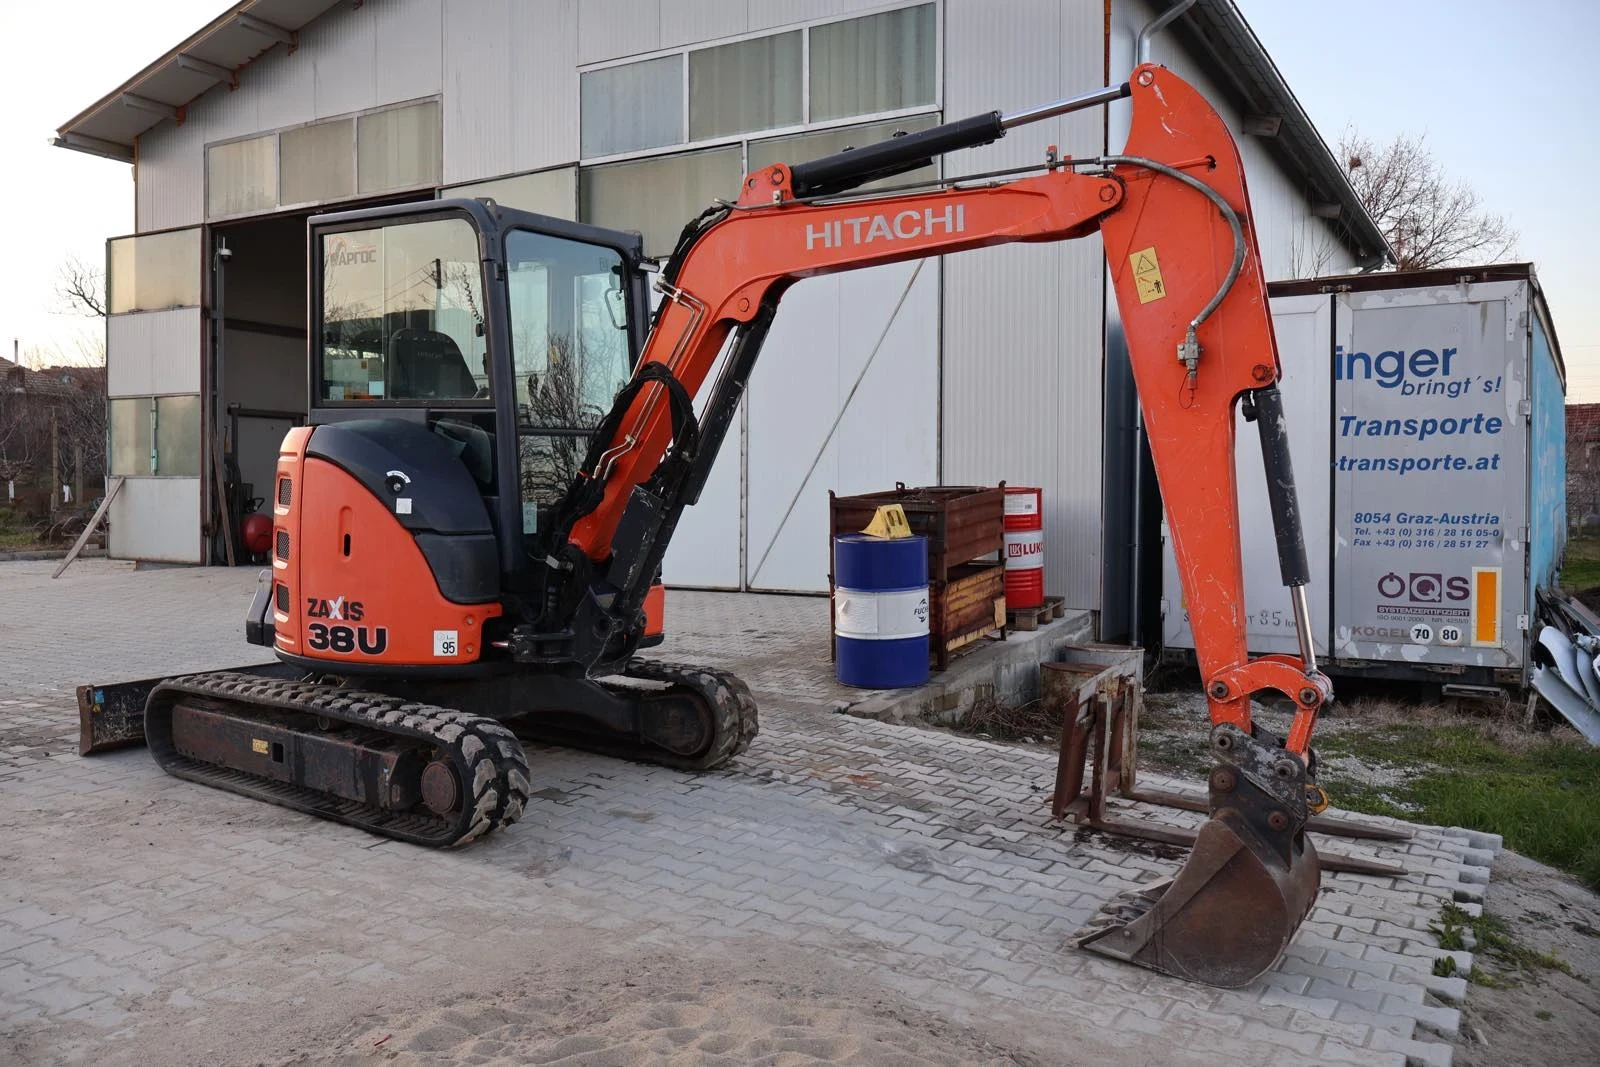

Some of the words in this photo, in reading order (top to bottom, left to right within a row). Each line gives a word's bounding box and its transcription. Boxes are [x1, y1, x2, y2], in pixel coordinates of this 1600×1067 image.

[806, 204, 965, 250] HITACHI
[1335, 345, 1457, 388] inger
[1339, 413, 1502, 441] Transporte
[1354, 512, 1391, 524] 8054
[1396, 512, 1500, 525] Graz-Austria
[1354, 527, 1371, 535] Tel.
[1375, 528, 1396, 536] +43
[1398, 528, 1412, 537] (0)
[1415, 528, 1434, 536] 316
[1443, 529, 1457, 537] 28
[1460, 529, 1473, 537] 16
[1475, 529, 1500, 537] 05-0
[1353, 538, 1371, 547] Fax
[1375, 539, 1395, 547] +43
[1398, 539, 1412, 548] (0)
[1415, 539, 1434, 548] 316
[1443, 540, 1457, 548] 28
[1459, 540, 1472, 548] 51
[1475, 540, 1489, 548] 27
[307, 595, 365, 622] ZAXIS
[1378, 606, 1470, 617] SYSTEMZERTIFIZIERT
[308, 623, 388, 655] 38U
[1414, 628, 1430, 639] 70
[1442, 629, 1458, 641] 80
[442, 641, 456, 654] 95
